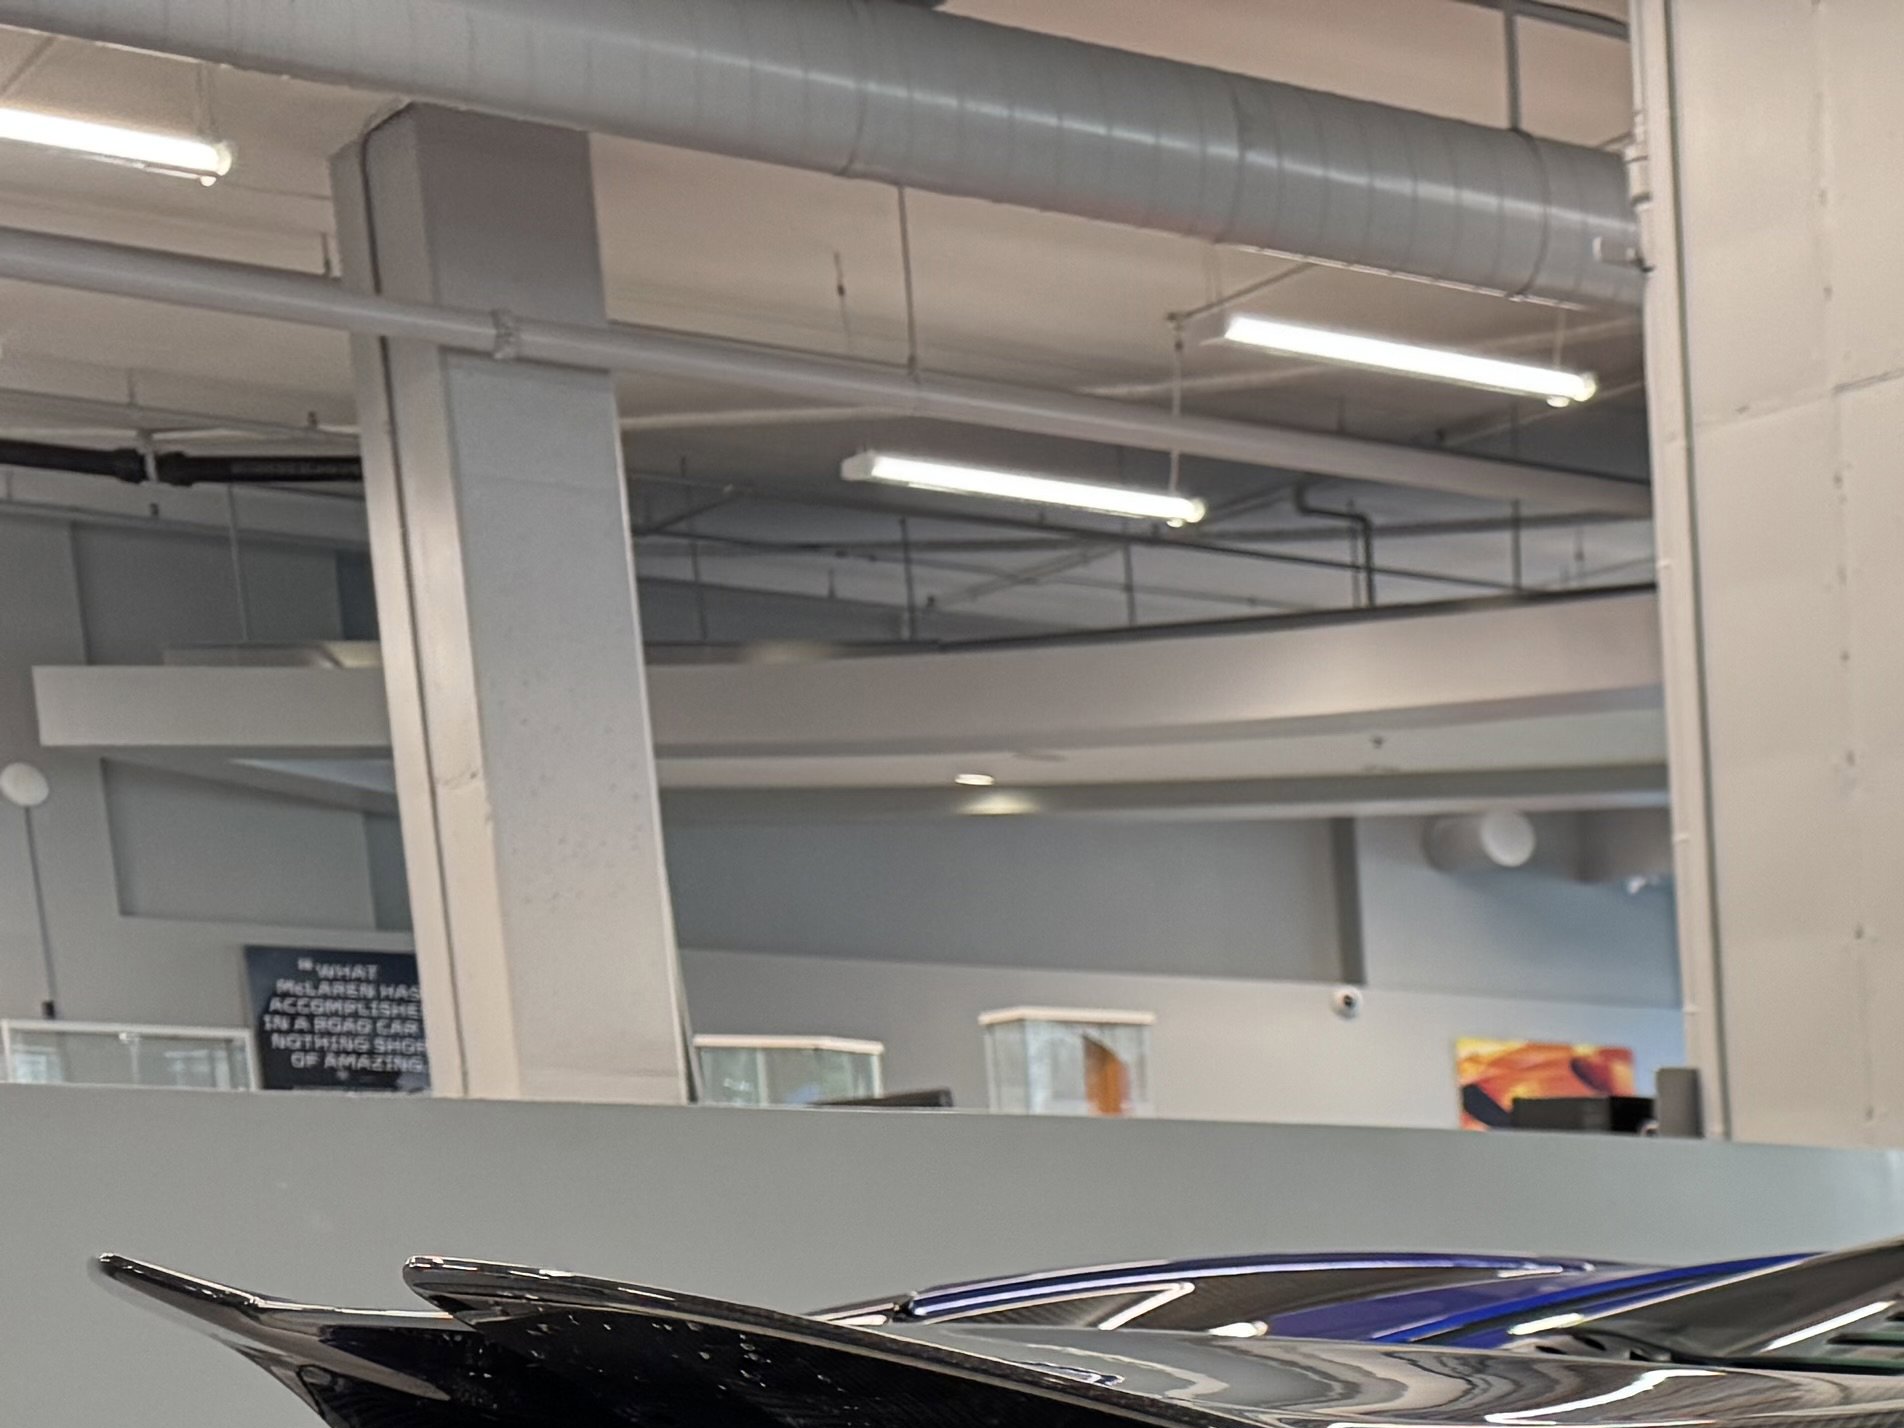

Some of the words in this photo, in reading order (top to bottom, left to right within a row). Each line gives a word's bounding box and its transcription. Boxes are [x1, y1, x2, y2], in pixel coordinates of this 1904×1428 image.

[276, 978, 376, 998] McLAREN
[379, 984, 420, 1000] HAS
[269, 997, 421, 1019] ACCOMPLISHE
[263, 1013, 290, 1031] IN
[294, 1017, 311, 1032] A
[314, 1017, 372, 1035] ROAD
[376, 1019, 418, 1036] CAR
[271, 1033, 370, 1053] NOTHING
[373, 1038, 426, 1056] SHO
[290, 1051, 321, 1069] OF
